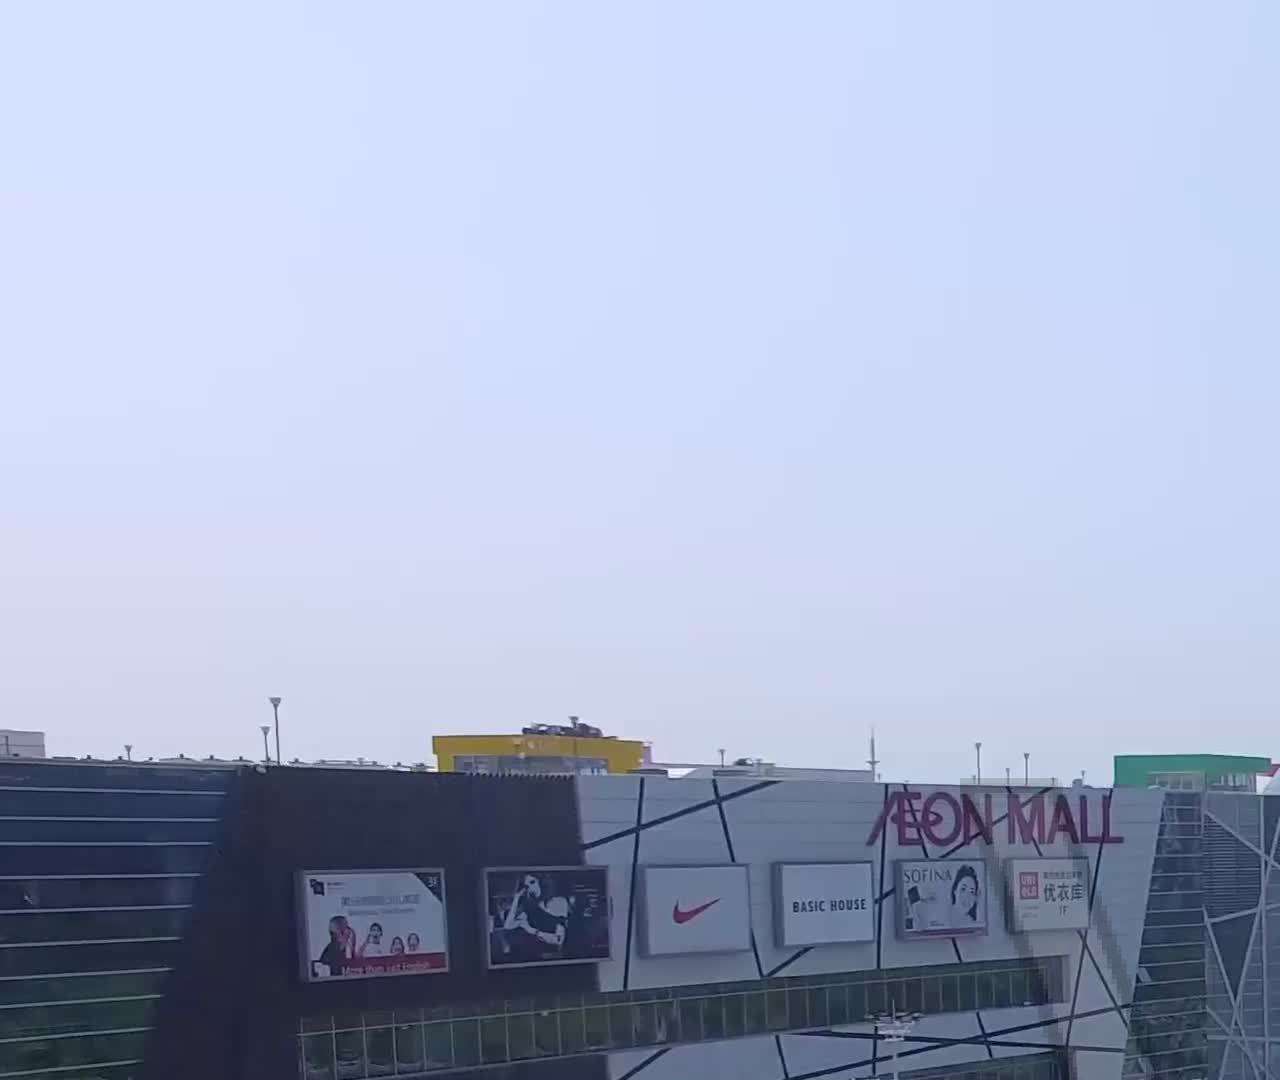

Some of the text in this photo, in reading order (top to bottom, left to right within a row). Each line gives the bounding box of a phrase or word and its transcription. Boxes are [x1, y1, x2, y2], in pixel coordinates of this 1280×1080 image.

[1007, 793, 1125, 845] MALL
[903, 867, 952, 884] SOFINA
[1044, 883, 1084, 902] 优衣库
[792, 898, 868, 913] BASIC HOUSE
